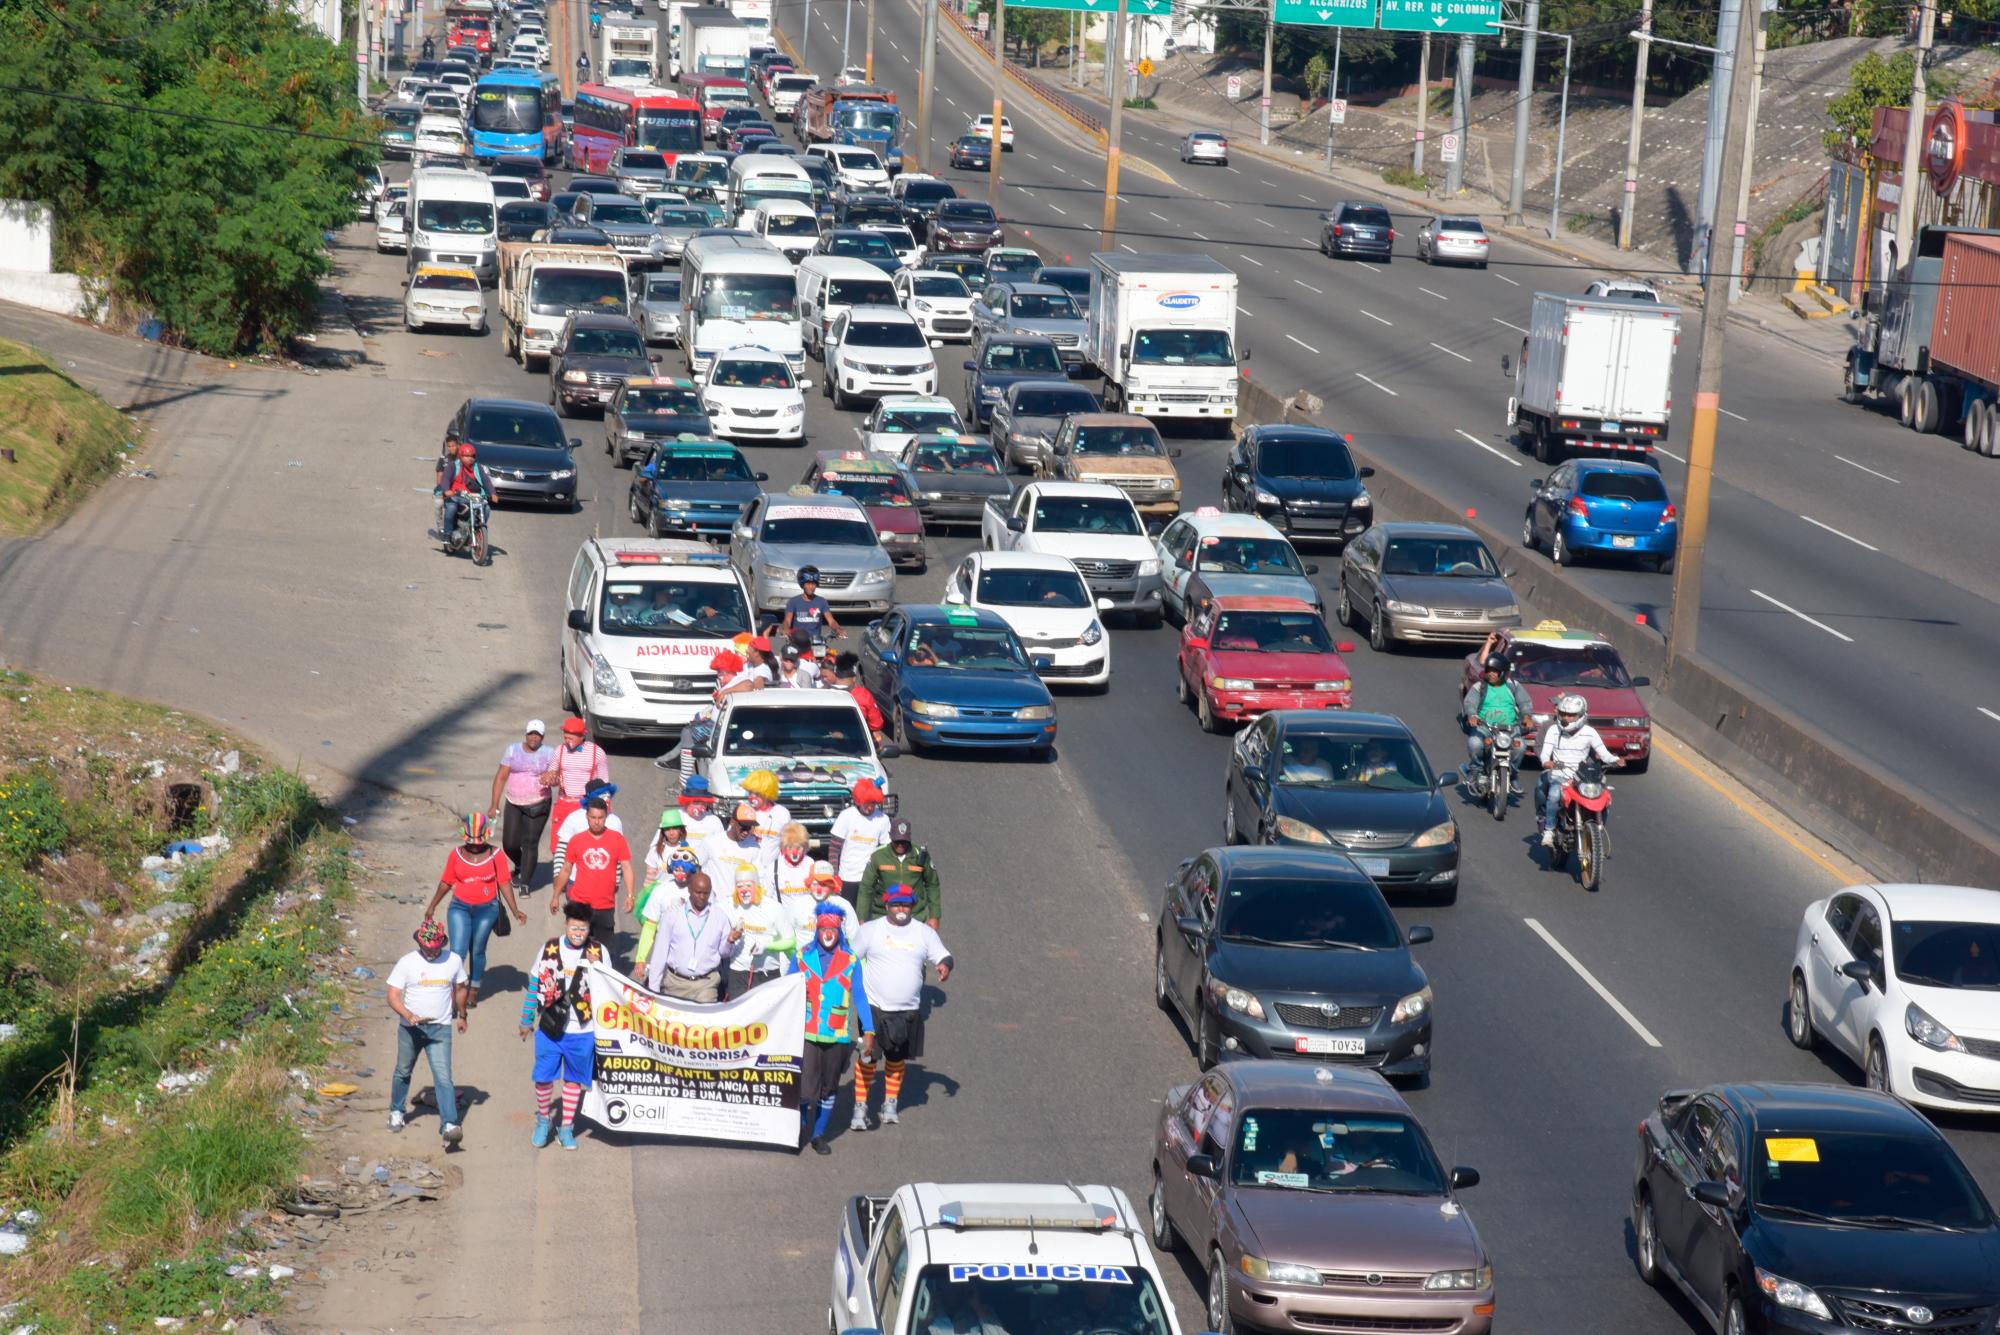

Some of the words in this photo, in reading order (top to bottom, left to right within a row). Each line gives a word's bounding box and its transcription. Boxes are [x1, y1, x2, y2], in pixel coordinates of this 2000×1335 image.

[1309, 0, 1367, 9] ALCARRIZOS
[1386, 0, 1400, 11] AV.
[1405, 1, 1424, 12] REP.
[1431, 2, 1443, 13] DE
[1447, 3, 1496, 15] COLOMBIA
[638, 117, 699, 127] TURISMO
[630, 1033, 654, 1049] POR
[658, 1044, 685, 1058] UNA
[690, 1049, 750, 1061] SONRISA
[602, 1056, 651, 1071] ABUSO
[655, 1062, 716, 1080] INFANTIL
[719, 1070, 740, 1080] NO
[743, 1069, 760, 1082] DA
[764, 1071, 794, 1085] RISA
[611, 1071, 661, 1084] SONRISA
[664, 1076, 679, 1086] EN
[681, 1079, 696, 1088] LA
[700, 1081, 750, 1093] INFANCIA
[752, 1083, 767, 1094] ES
[769, 1084, 783, 1095] EL
[682, 1089, 697, 1098] DE
[700, 1090, 723, 1102] UNA
[725, 1093, 751, 1105] VIDA
[752, 1095, 783, 1107] FELIZ
[633, 1104, 665, 1119] Gall
[950, 1264, 1134, 1284] POLICIA
